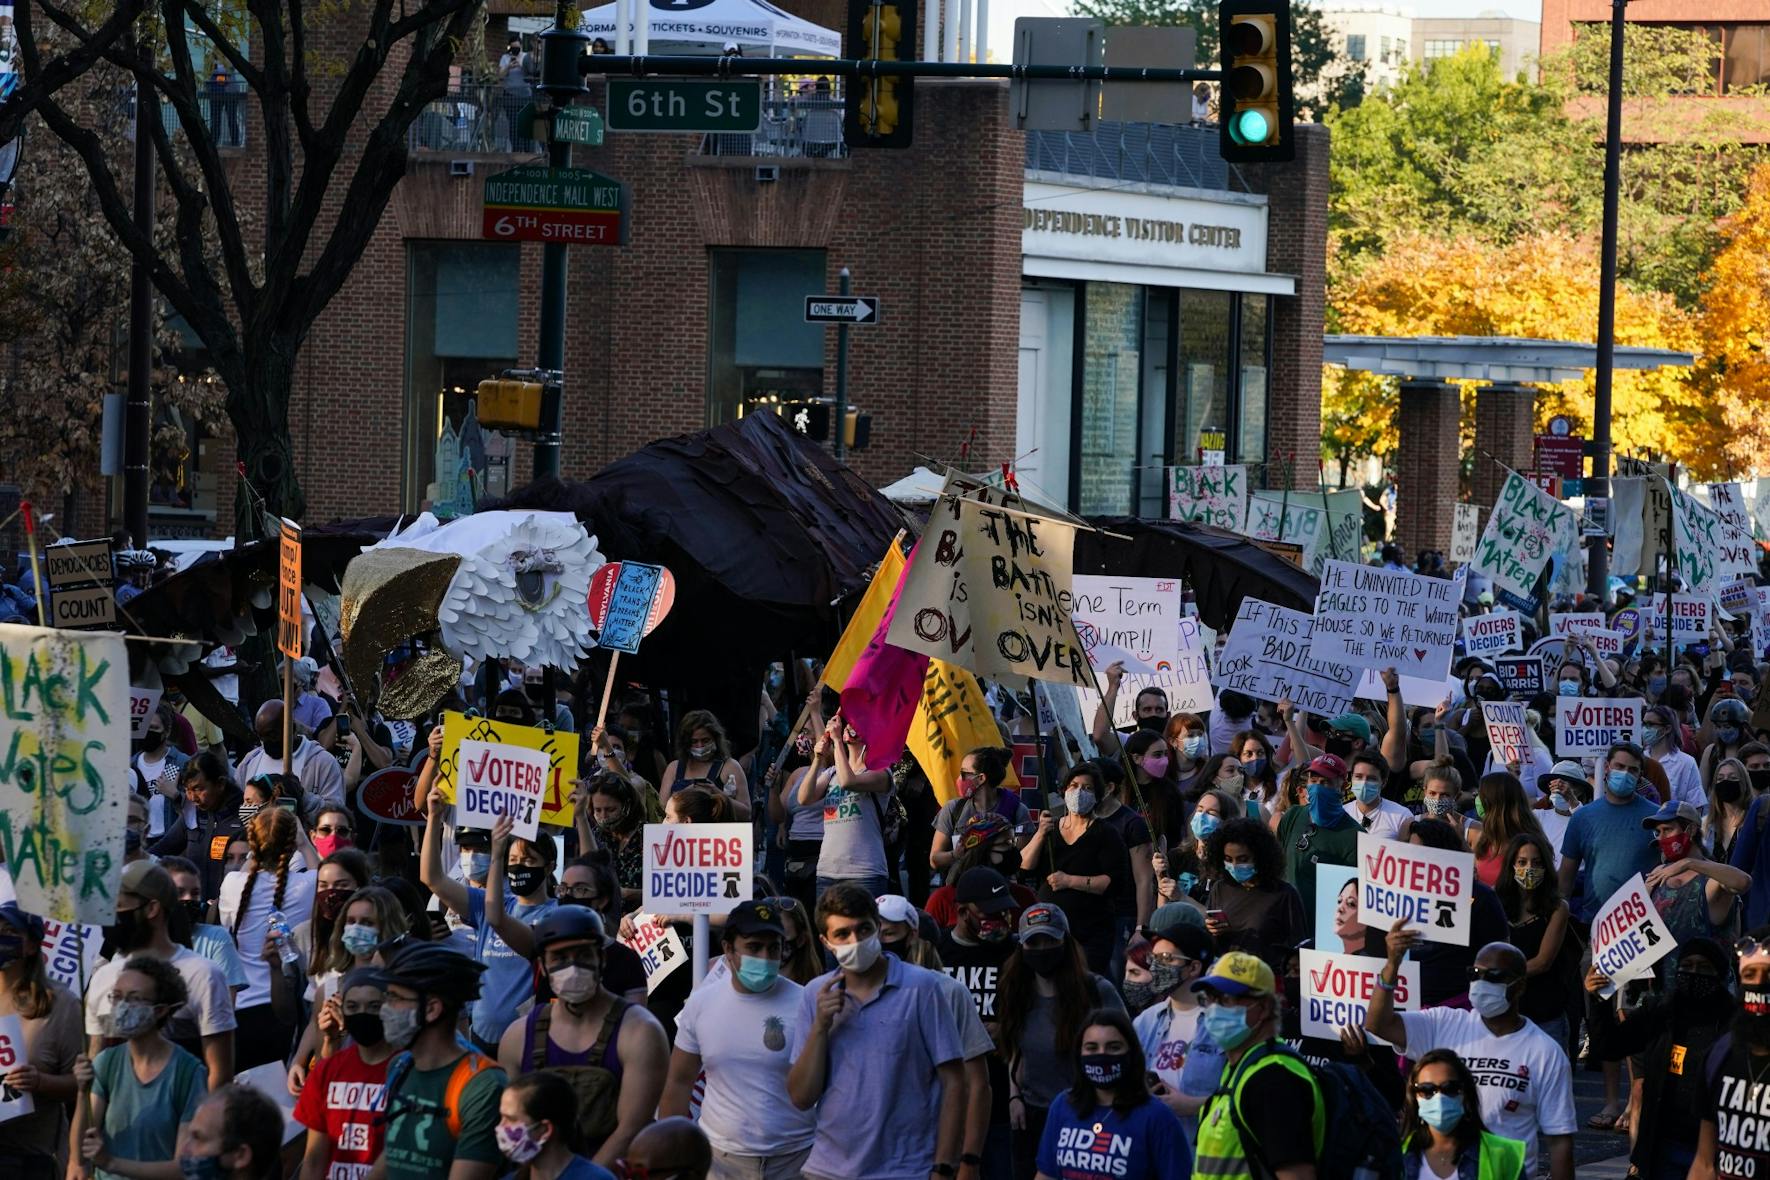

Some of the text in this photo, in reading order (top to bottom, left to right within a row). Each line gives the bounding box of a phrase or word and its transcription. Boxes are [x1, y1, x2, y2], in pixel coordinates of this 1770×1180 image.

[652, 22, 695, 33] TICKETS
[706, 25, 768, 37] SOUVENIRS
[628, 89, 741, 117] 6th St
[555, 118, 604, 143] MARKET ST
[485, 182, 620, 208] INDEPENDENCE MALL WEST
[494, 215, 607, 239] 6TH STREET
[1024, 208, 1242, 249] DEPENDENCE VISITOR CENTER
[813, 304, 857, 316] ONE WAY
[1712, 485, 1732, 507] THE
[979, 509, 1044, 557] THE
[50, 553, 109, 576] DEMOCRACIES
[1325, 565, 1450, 602] HE UNINVITED THE
[59, 597, 108, 619] COUNT
[597, 568, 614, 631] NNSYLVANIA
[1109, 586, 1162, 616] Term
[1318, 591, 1456, 626] EAGLES TO THE WHITE
[1657, 598, 1706, 616] VTERS
[1266, 606, 1298, 636] This
[1360, 620, 1374, 636] SO
[1380, 623, 1395, 640] WE
[1401, 624, 1454, 647] RETURNED
[1469, 617, 1515, 638] VOTERS
[1655, 617, 1692, 630] DEIDE
[1343, 639, 1411, 661] THE FAVOR
[1470, 634, 1505, 651] DECIDE
[997, 628, 1089, 688] OVER
[1218, 655, 1254, 677] LOOK
[1499, 664, 1539, 677] BIDEN
[1269, 677, 1292, 698] I'M
[1296, 685, 1327, 710] INTO
[1329, 696, 1353, 714] IT
[1484, 704, 1522, 722] COUNT
[1565, 702, 1634, 727] VOTERS
[1488, 725, 1527, 745] EVERY
[1565, 730, 1617, 746] DECIDE
[1495, 745, 1533, 764] VOTE
[466, 749, 541, 795] VOTERS
[466, 788, 526, 820] DECIDE
[839, 803, 862, 818] PA
[652, 830, 743, 868] VOTERS
[1366, 845, 1460, 897] VOTERS
[652, 872, 717, 898] DECIDE
[1366, 884, 1430, 924] DECIDE
[1593, 892, 1647, 954] VOTERS
[1310, 960, 1409, 1004] VOTES
[1310, 998, 1367, 1028] DECID
[1719, 1075, 1770, 1117] TAKE
[341, 1128, 365, 1146] IS
[1057, 1127, 1133, 1158] BIDEN
[1717, 1110, 1770, 1151] BACK
[1056, 1149, 1128, 1177] HARRIS
[1719, 1150, 1756, 1179] 2020
